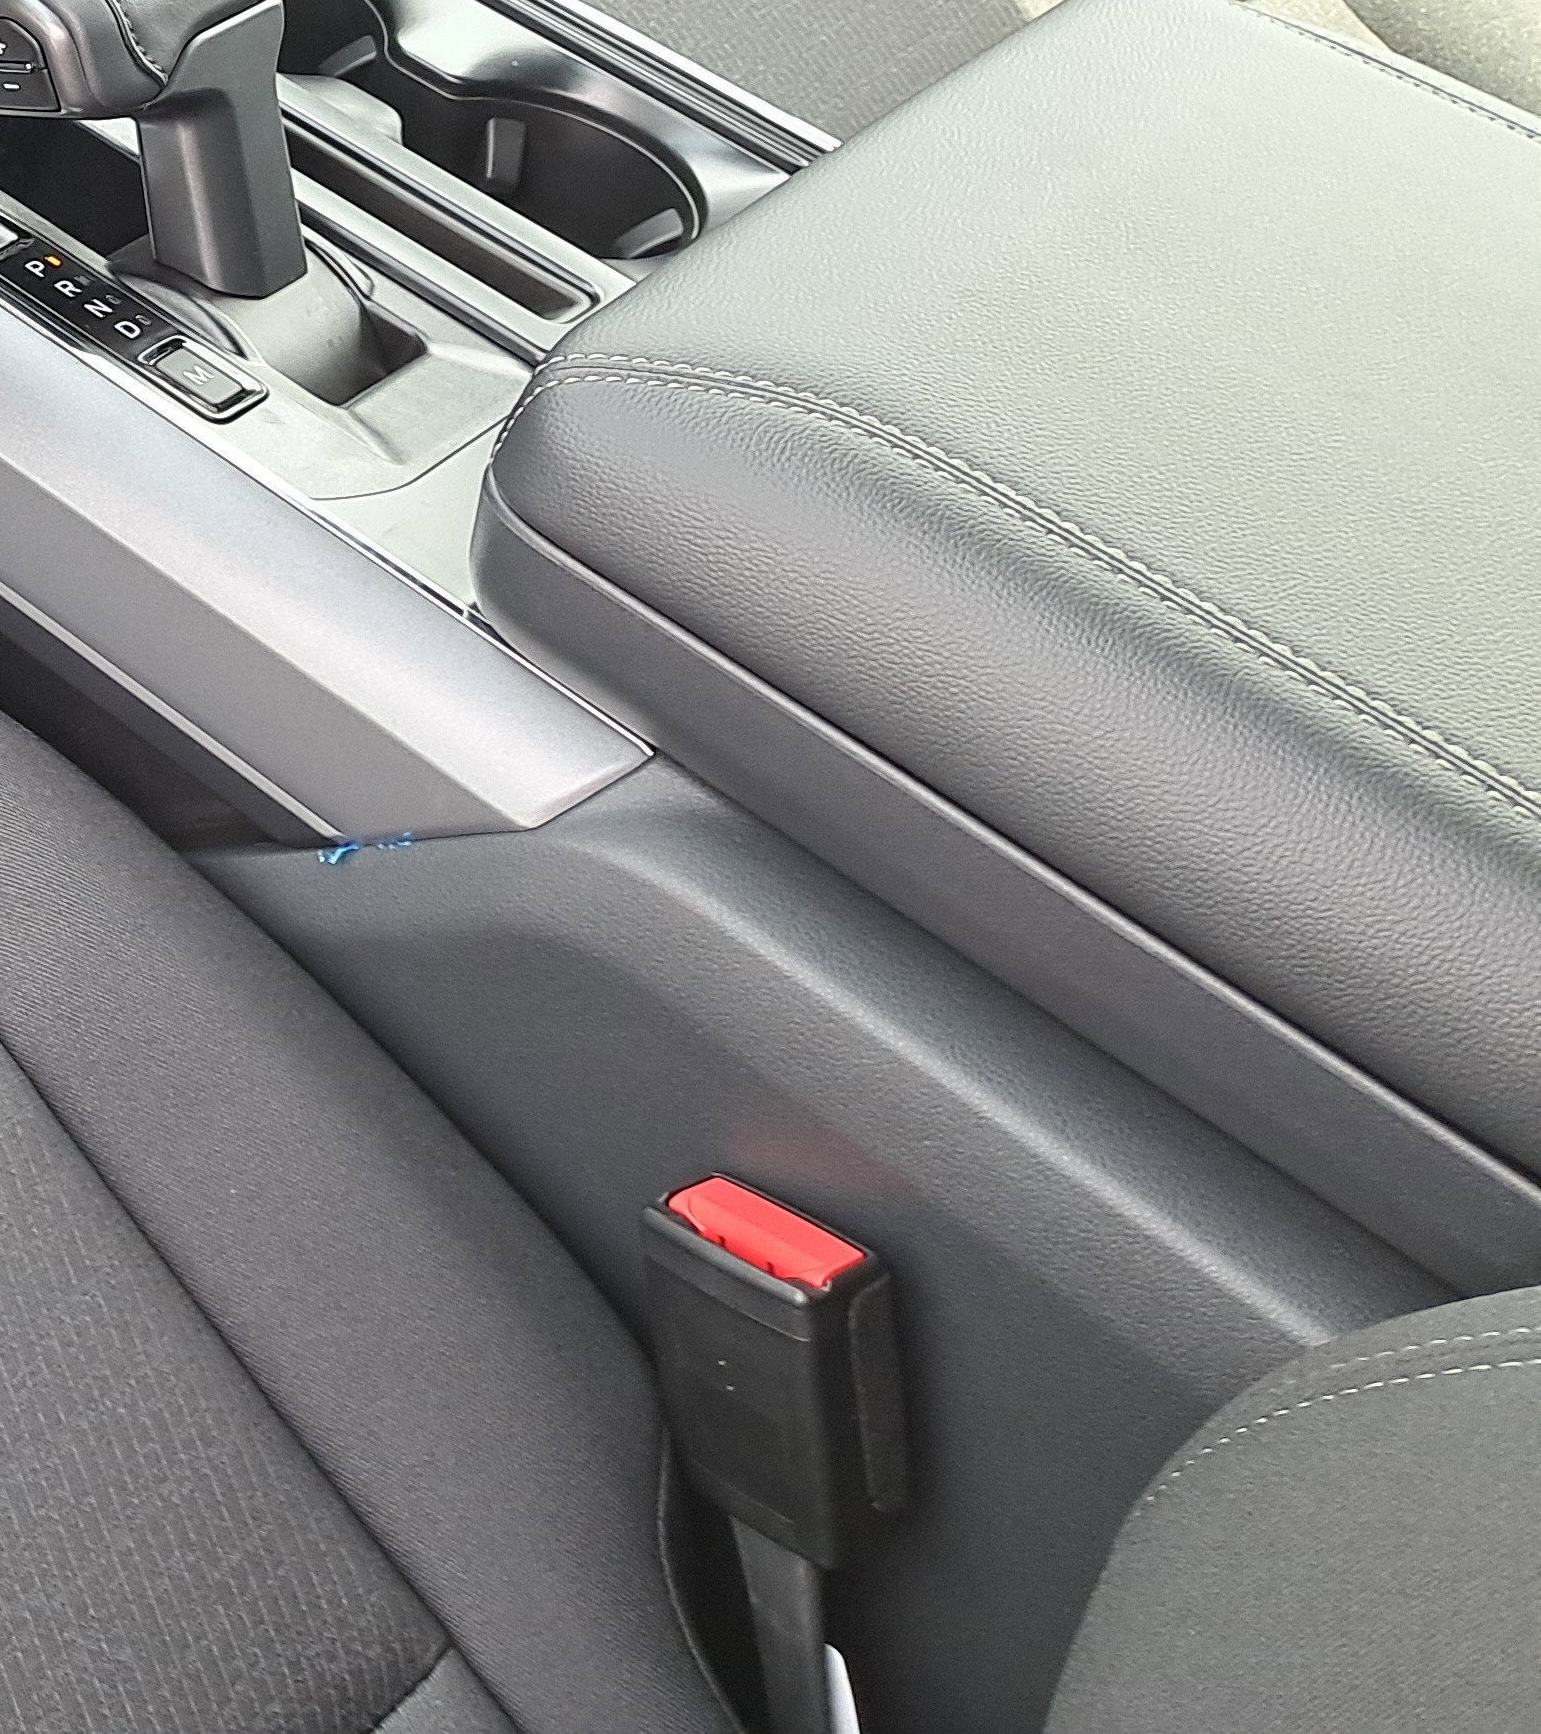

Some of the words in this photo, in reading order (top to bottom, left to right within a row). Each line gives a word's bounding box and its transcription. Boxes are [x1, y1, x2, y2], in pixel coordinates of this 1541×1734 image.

[24, 260, 46, 278] P
[54, 280, 82, 298] R
[83, 298, 114, 318] N
[114, 320, 141, 339] D
[182, 365, 215, 386] M
